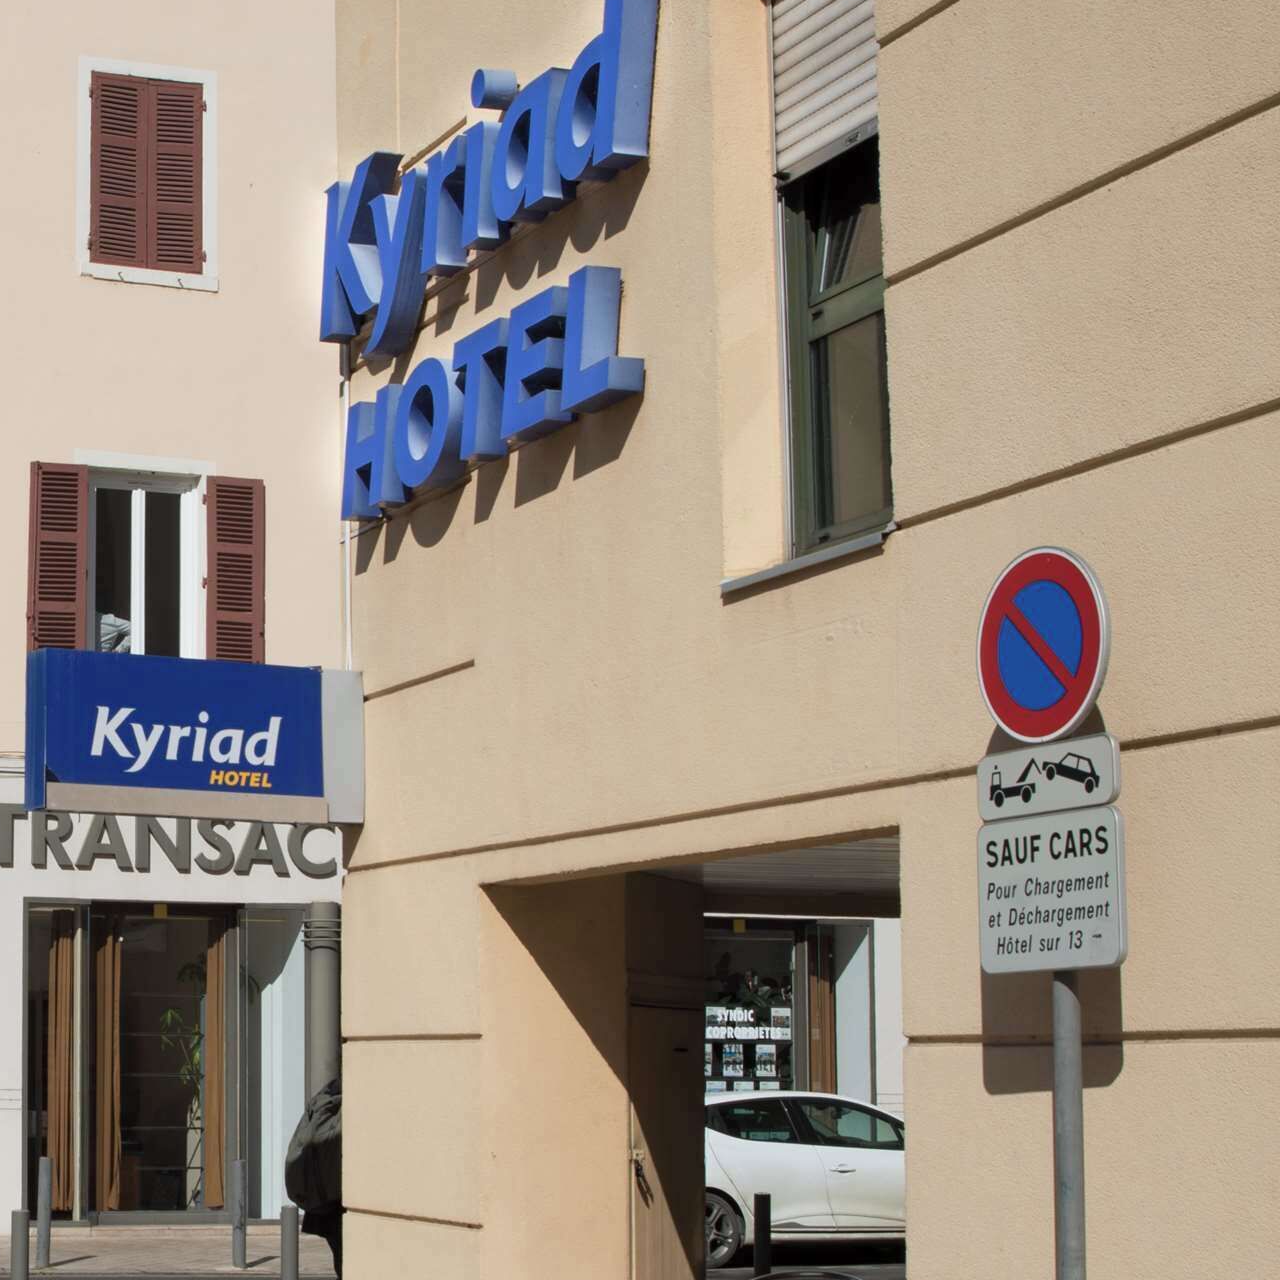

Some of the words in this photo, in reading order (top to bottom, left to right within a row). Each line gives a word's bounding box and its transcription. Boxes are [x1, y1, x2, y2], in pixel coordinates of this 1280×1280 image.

[341, 265, 644, 520] HOTEL
[90, 705, 282, 773] Kyriad
[209, 769, 272, 788] HOTEL
[986, 834, 1041, 868] SAUF
[1049, 826, 1109, 860] CARS
[987, 882, 1017, 901] Pour
[1024, 871, 1109, 899] Chargement
[988, 911, 1002, 928] et
[1009, 901, 1110, 927] Déchargement
[997, 935, 1033, 955] Hôtel
[1039, 936, 1061, 952] sur
[1069, 930, 1083, 949] 13
[717, 1009, 754, 1022] SYNDIC
